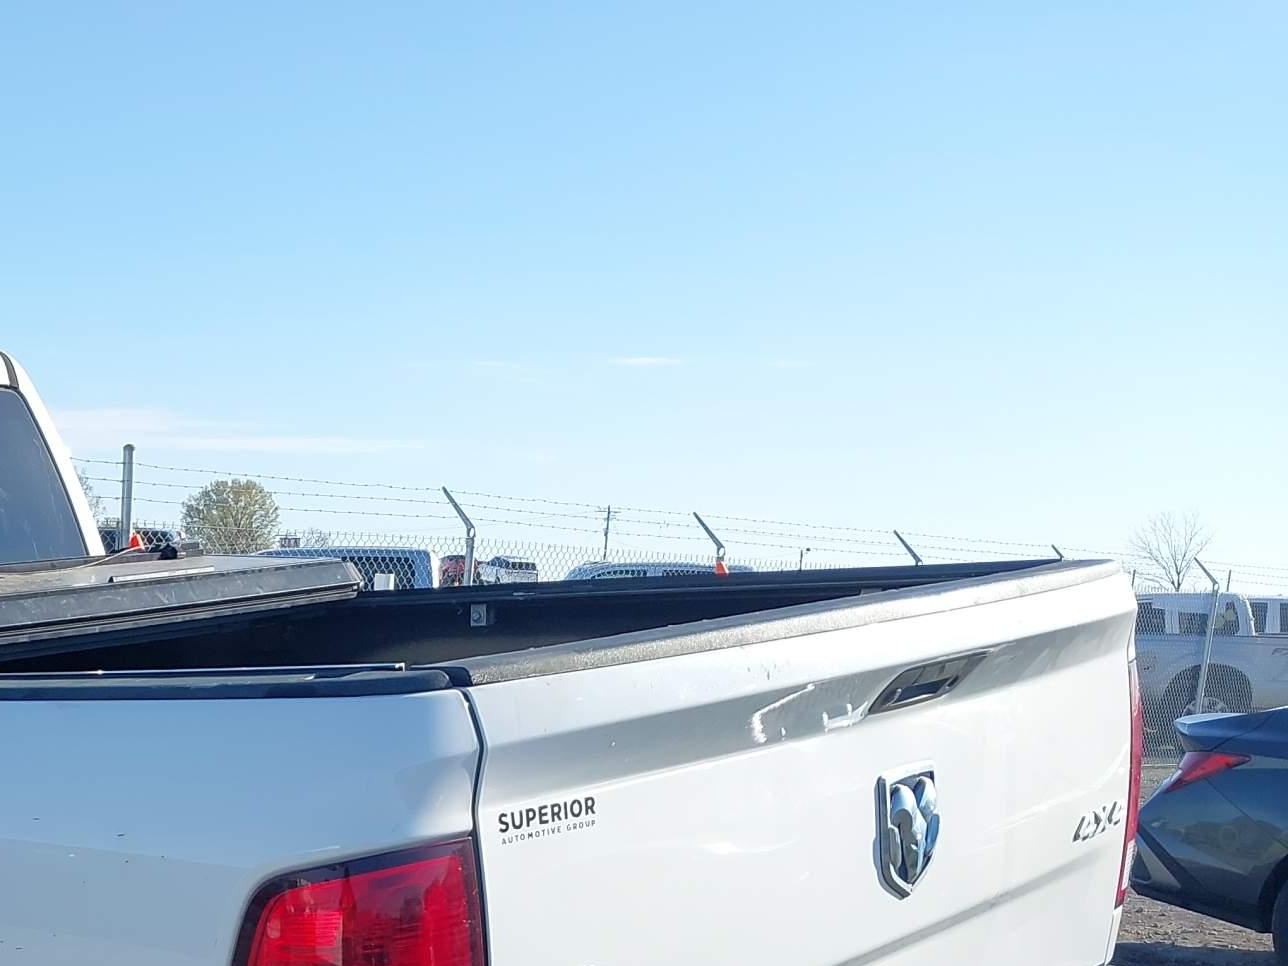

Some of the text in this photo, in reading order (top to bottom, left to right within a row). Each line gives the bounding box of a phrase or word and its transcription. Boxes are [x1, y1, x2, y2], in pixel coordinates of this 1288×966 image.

[498, 796, 596, 834] SUPERIOR
[501, 819, 597, 846] AUTOMOTIVE GROUP
